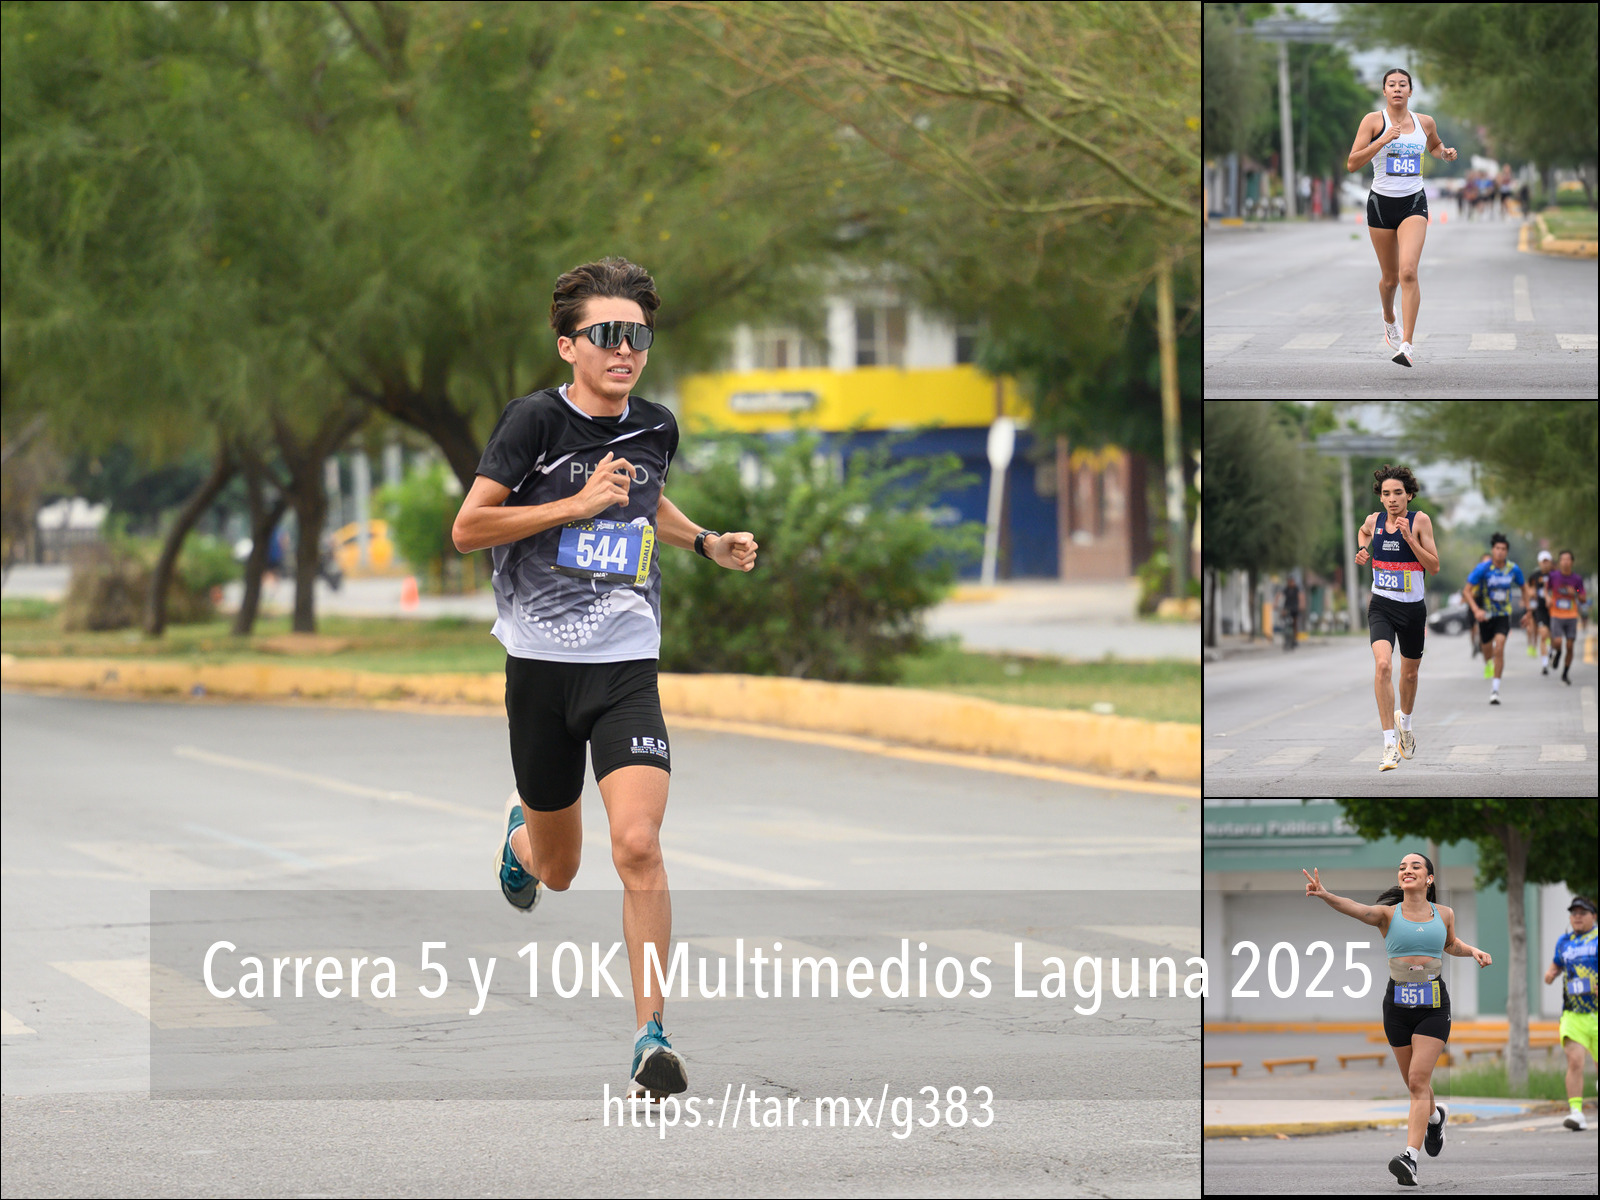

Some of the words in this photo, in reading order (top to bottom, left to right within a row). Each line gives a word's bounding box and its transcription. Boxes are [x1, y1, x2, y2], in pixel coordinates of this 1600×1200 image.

[1394, 159, 1415, 173] 645
[576, 532, 628, 572] 544
[641, 539, 652, 572] MEDALLA
[1378, 573, 1398, 588] 528
[631, 736, 667, 751] IED
[1401, 988, 1425, 1004] 551
